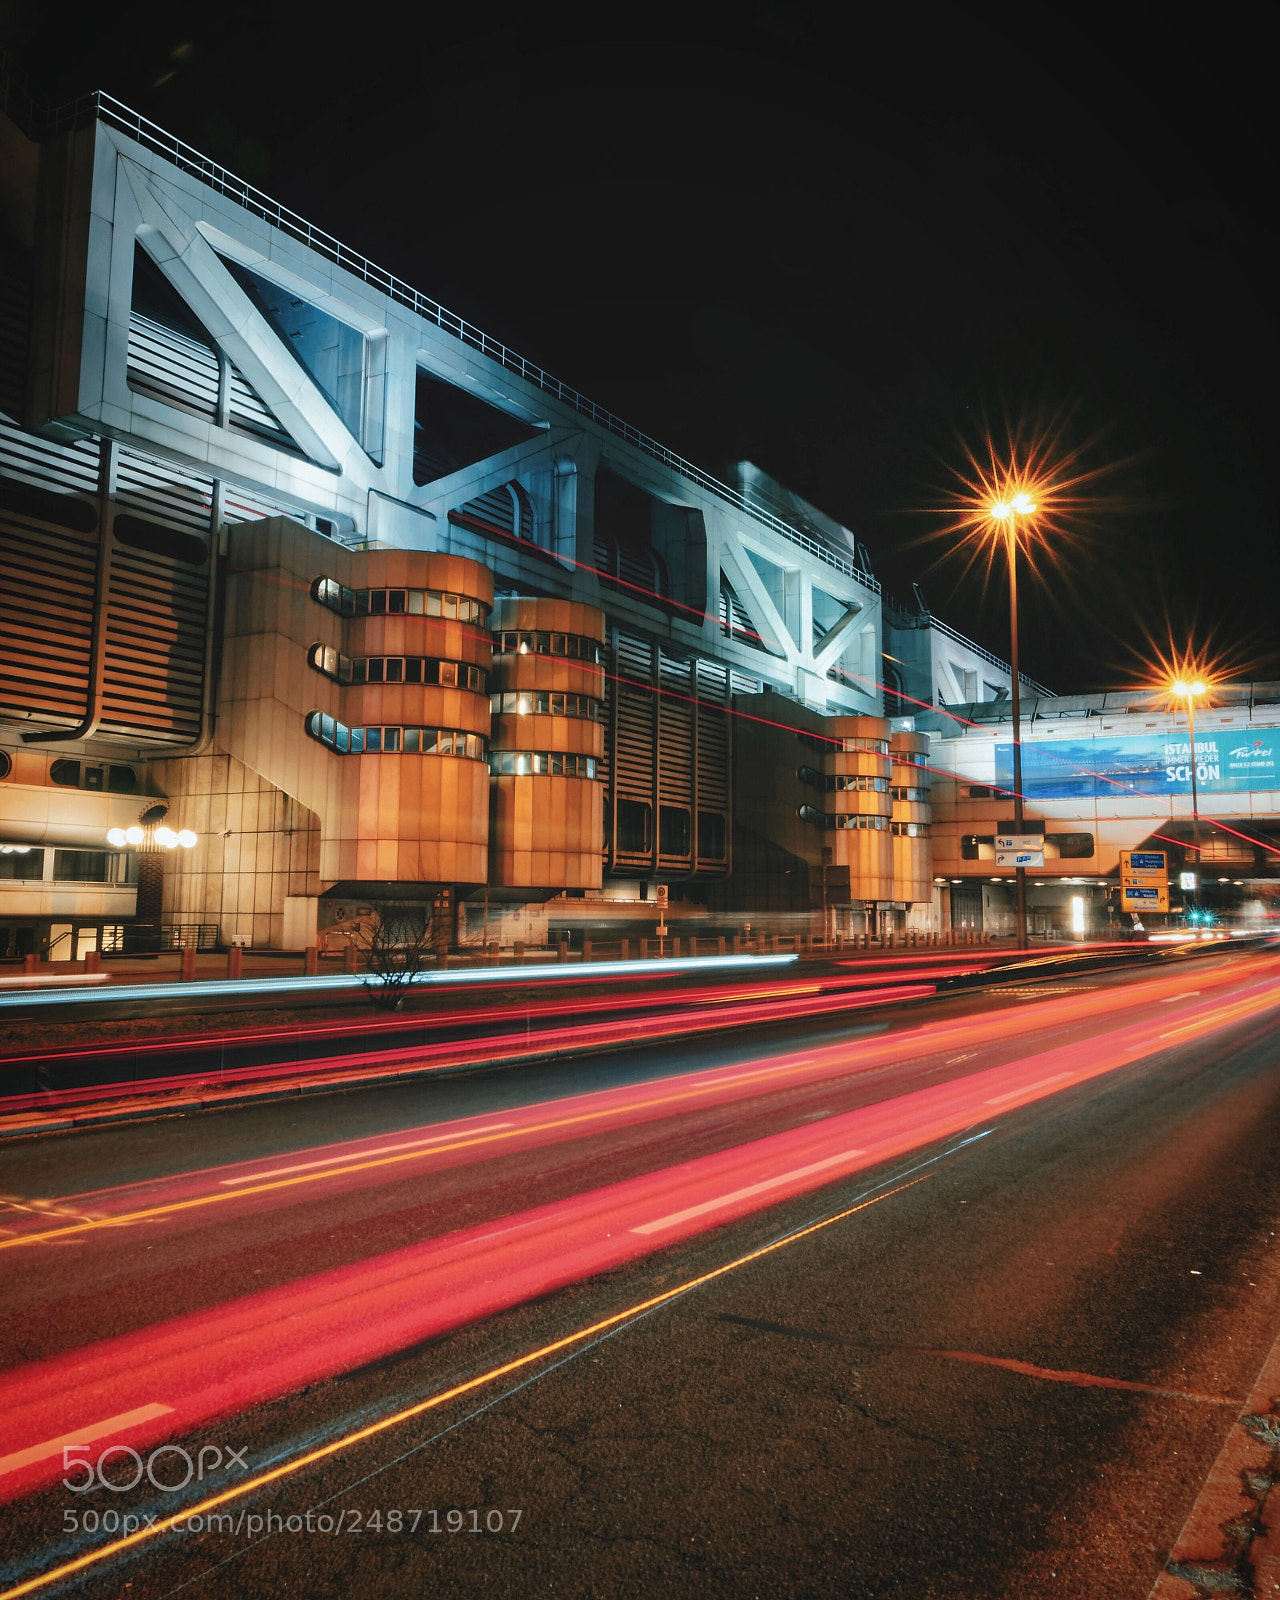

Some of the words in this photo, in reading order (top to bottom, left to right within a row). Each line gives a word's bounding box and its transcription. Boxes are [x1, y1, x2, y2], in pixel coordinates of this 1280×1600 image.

[1165, 741, 1219, 755] ISTANBUL
[1165, 756, 1189, 765] IMMER
[1165, 763, 1220, 782] SCHÖN
